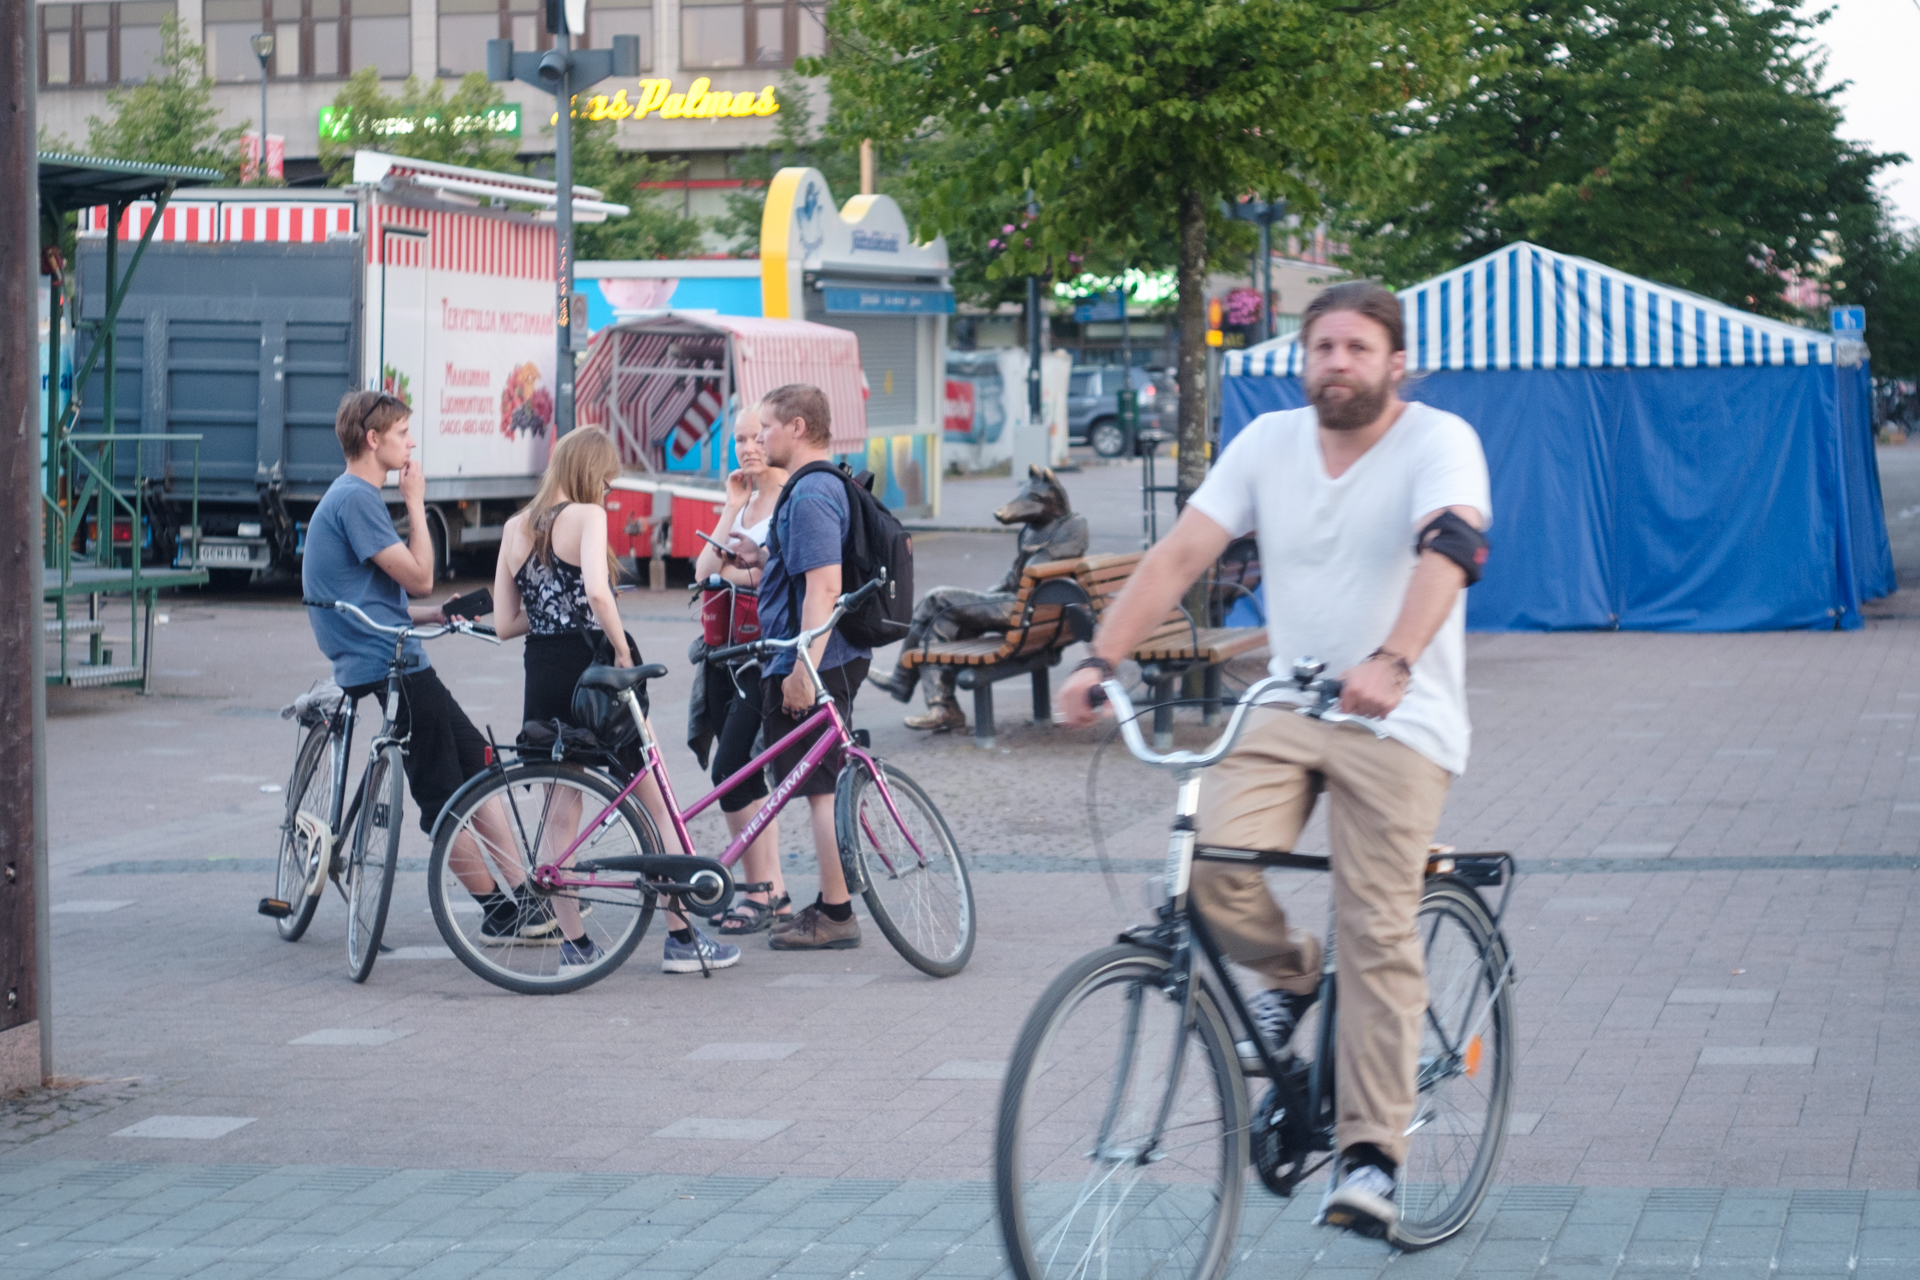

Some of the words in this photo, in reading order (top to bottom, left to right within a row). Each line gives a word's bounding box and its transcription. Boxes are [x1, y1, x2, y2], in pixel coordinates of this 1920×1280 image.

[550, 88, 635, 126] as
[633, 76, 780, 120] Palmas
[740, 760, 811, 844] HELKAMA
